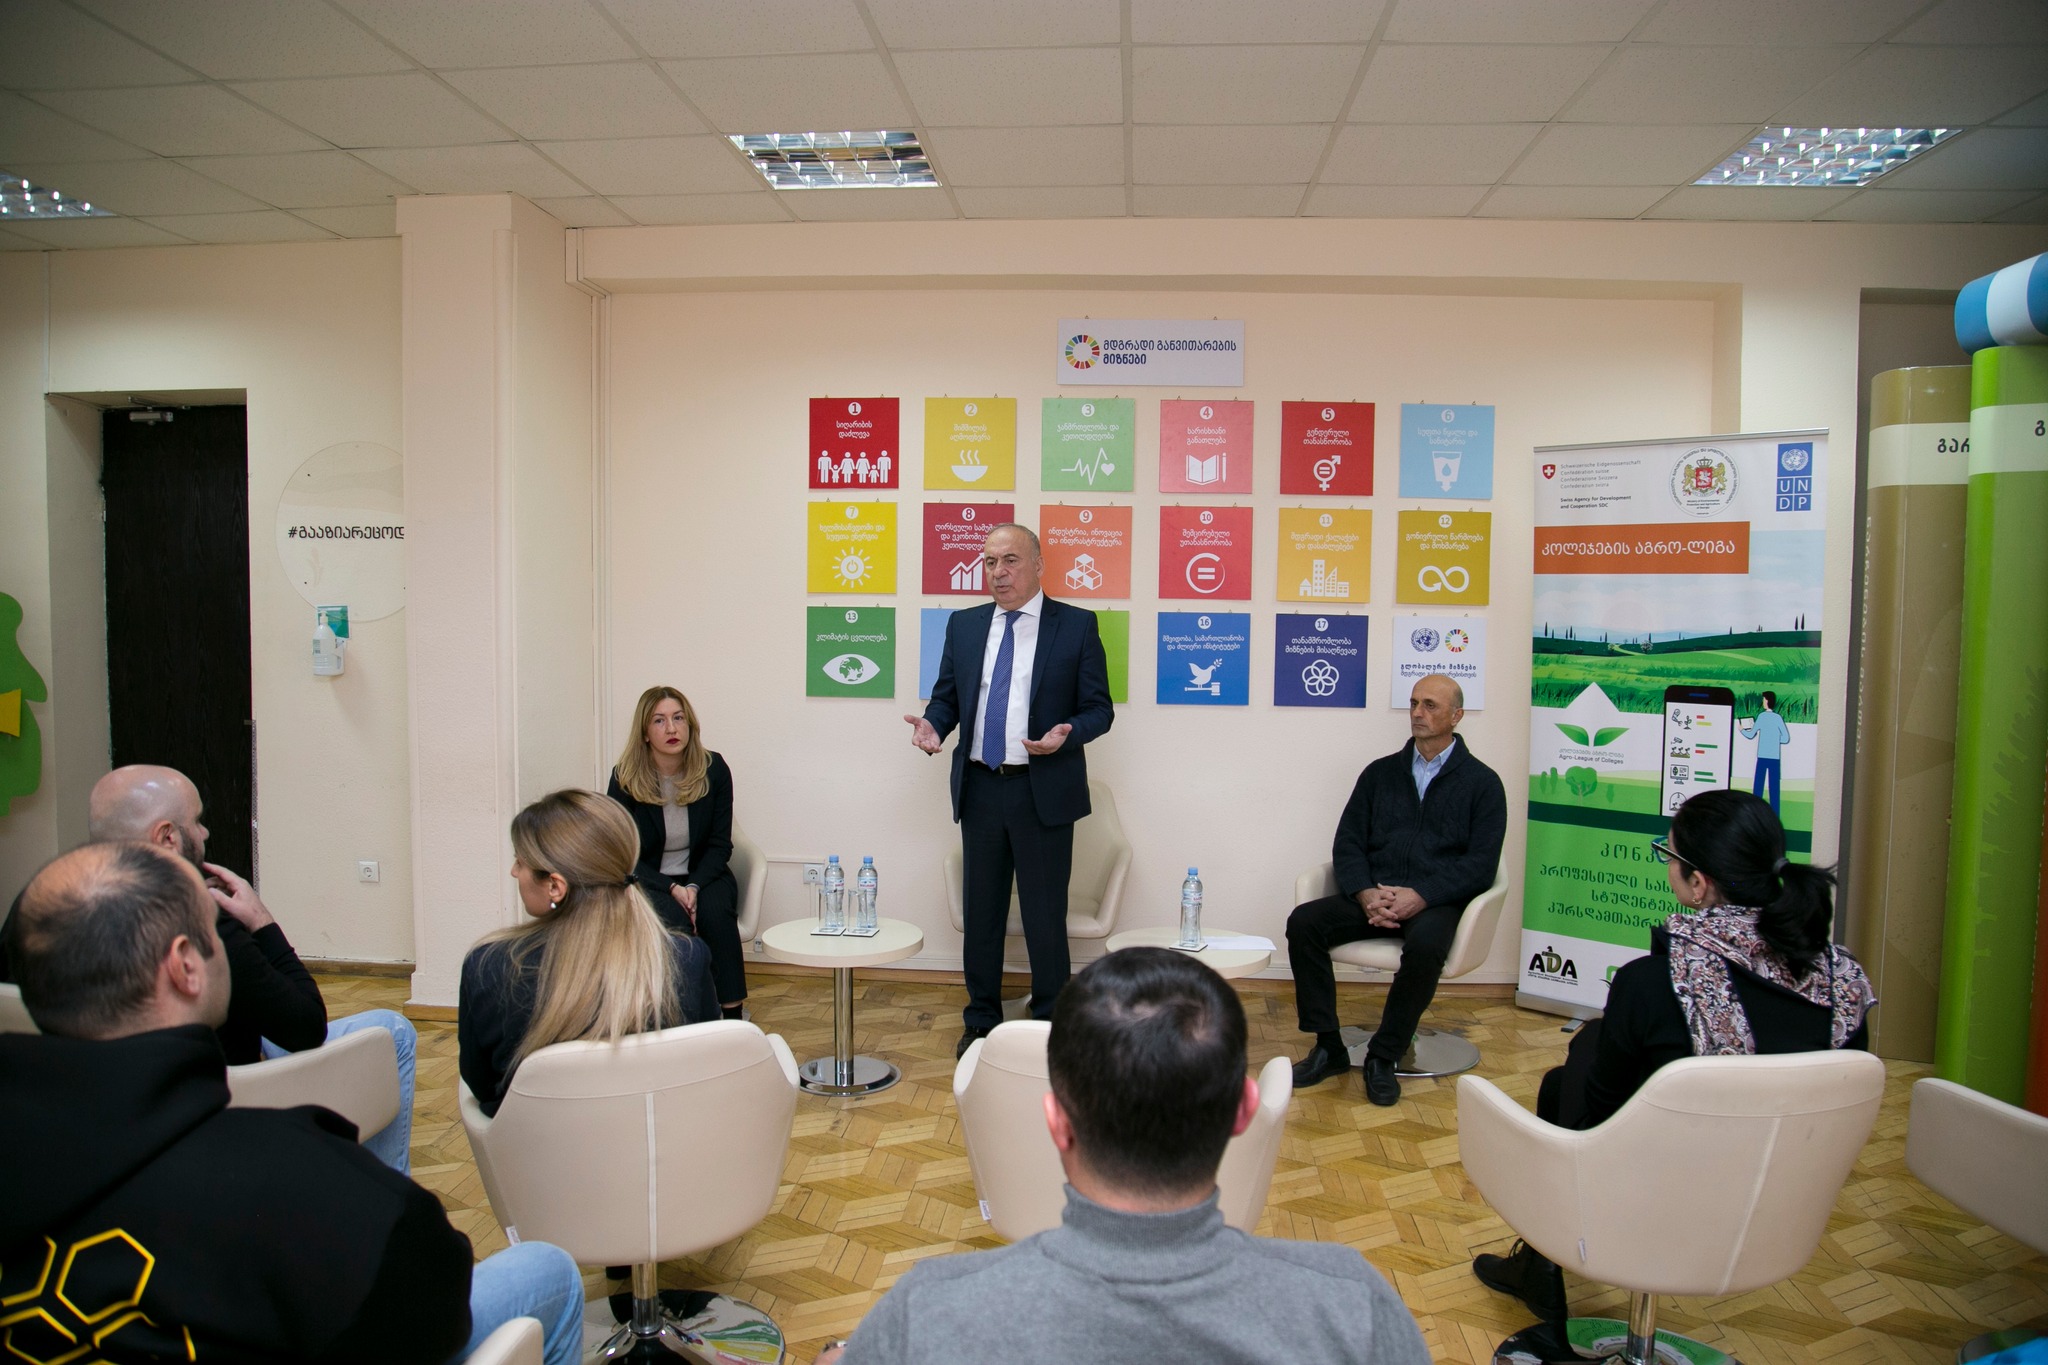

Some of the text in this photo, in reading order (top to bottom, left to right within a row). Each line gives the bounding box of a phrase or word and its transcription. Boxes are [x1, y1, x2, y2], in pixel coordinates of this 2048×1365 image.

[1103, 339, 1237, 351] მდგრადი განვითარების
[1102, 353, 1146, 365] მიზნები
[851, 403, 858, 413] 1
[967, 405, 975, 415] 2
[1084, 405, 1092, 415] 3
[1202, 407, 1210, 418] 4
[1324, 409, 1332, 420] 5
[1444, 410, 1452, 421] 6
[836, 420, 873, 429] სიღარიბის
[1109, 424, 1119, 432] და
[838, 430, 870, 440] დაძლევა
[1187, 426, 1226, 436] ხარისხიანი
[1306, 428, 1350, 438] გენდერული
[1186, 436, 1226, 446] განათლება
[1303, 437, 1353, 446] თანასწორობა
[1574, 496, 1591, 504] Agency
[1600, 495, 1632, 503] Development
[1570, 502, 1597, 510] Cooperation
[849, 507, 856, 517] 7
[965, 508, 973, 519] 8
[1082, 511, 1090, 521] 9
[1201, 513, 1212, 522] 10
[1320, 516, 1331, 525] 11
[1440, 516, 1451, 526] 12
[935, 523, 973, 533] ღირსეული
[1091, 528, 1123, 538] ინოვაცია
[1182, 528, 1231, 538] შემცირებული
[940, 533, 951, 541] და
[1047, 537, 1123, 547] და ინფრასტრუქტურა
[1179, 538, 1233, 548] უთანასწორობა
[1295, 543, 1306, 551] და
[1419, 543, 1430, 551] და
[1541, 540, 1736, 556] კოლეჯების აგრო-ლიგა
[847, 612, 857, 621] 13
[1199, 618, 1209, 627] 16
[1317, 620, 1326, 629] 17
[815, 633, 888, 643] კლიმატის ცვლილება
[1194, 634, 1245, 643] სამართლიანობა
[1291, 636, 1352, 646] თანამშრომლობა
[1166, 643, 1176, 651] და
[1176, 643, 1202, 651] ძლიერი
[1400, 662, 1477, 672] გლობალური მიზნები
[1559, 753, 1594, 762] Agro-League
[1600, 757, 1624, 765] Colleges
[1600, 842, 1656, 864] კონკ
[1540, 864, 1675, 894] პროფესიული სას
[1547, 902, 1666, 929] კურსდამთავრე
[1528, 950, 1578, 980] ADA
